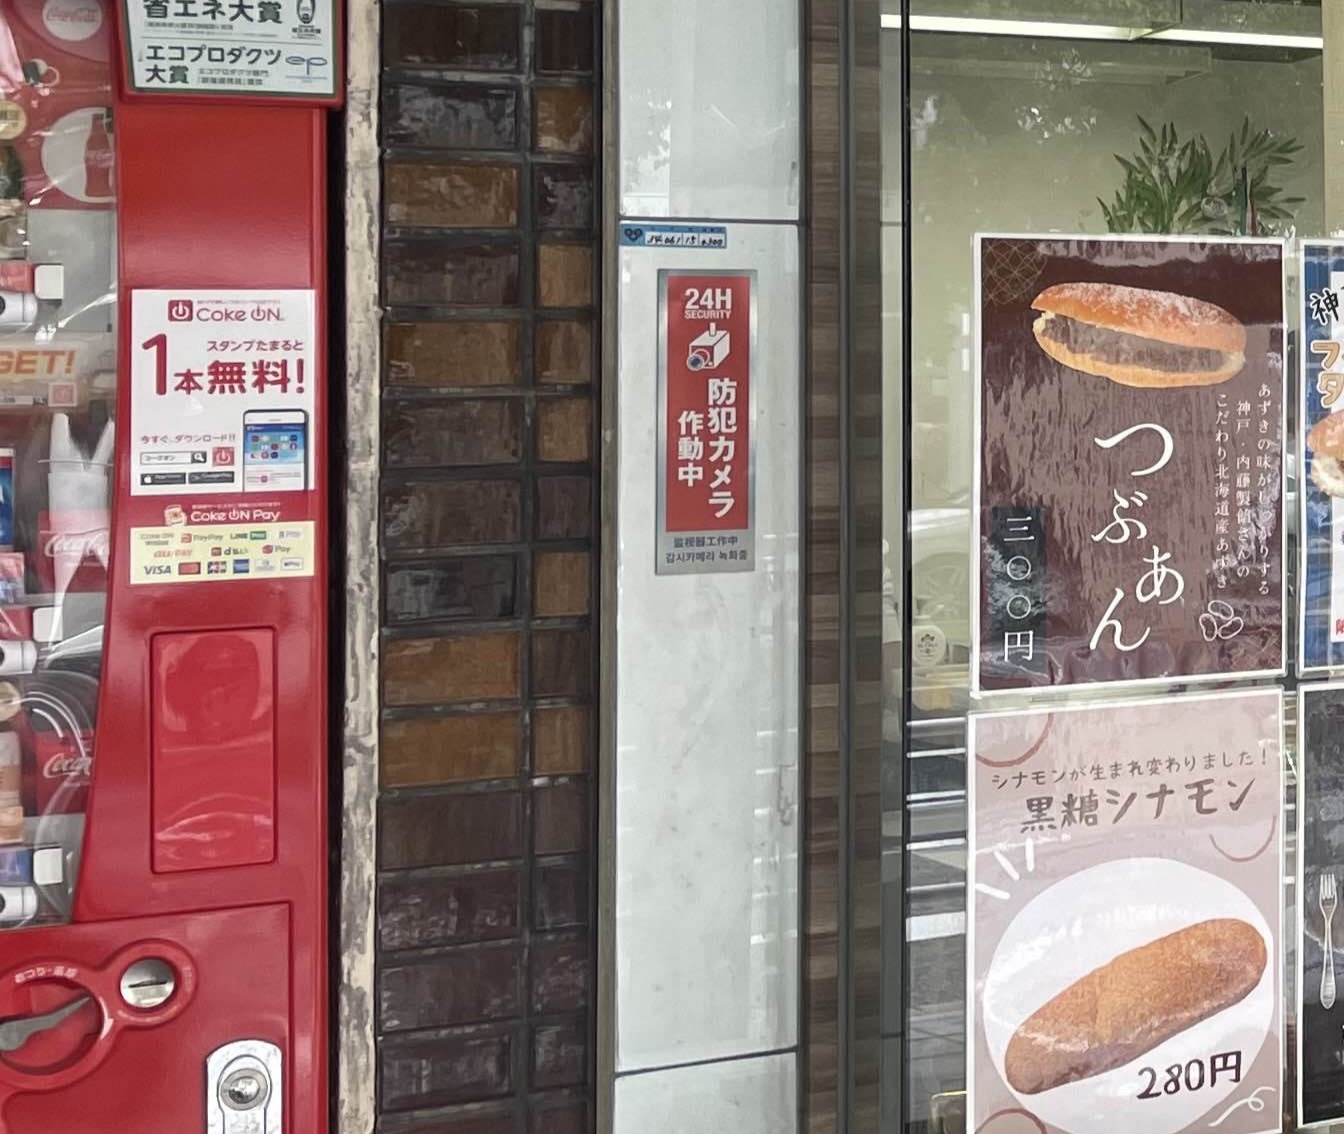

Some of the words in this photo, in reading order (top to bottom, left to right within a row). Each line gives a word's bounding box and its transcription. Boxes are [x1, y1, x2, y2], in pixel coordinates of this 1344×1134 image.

[146, 44, 283, 65] エコプロダクツ
[145, 65, 190, 85] 大賞
[684, 287, 732, 310] 24H
[196, 307, 247, 322] Coke
[684, 309, 732, 320] SECURITY
[206, 339, 304, 353] スタンプたまると
[677, 410, 704, 487] 作動中
[707, 378, 737, 518] 防犯カメラ
[190, 510, 227, 522] Coke
[253, 509, 281, 523] Pay
[1089, 422, 1185, 653] つぶあん
[143, 565, 172, 575] VISA
[1020, 776, 1256, 834] 黒糖シナモン
[1136, 1050, 1243, 1101] 280円
